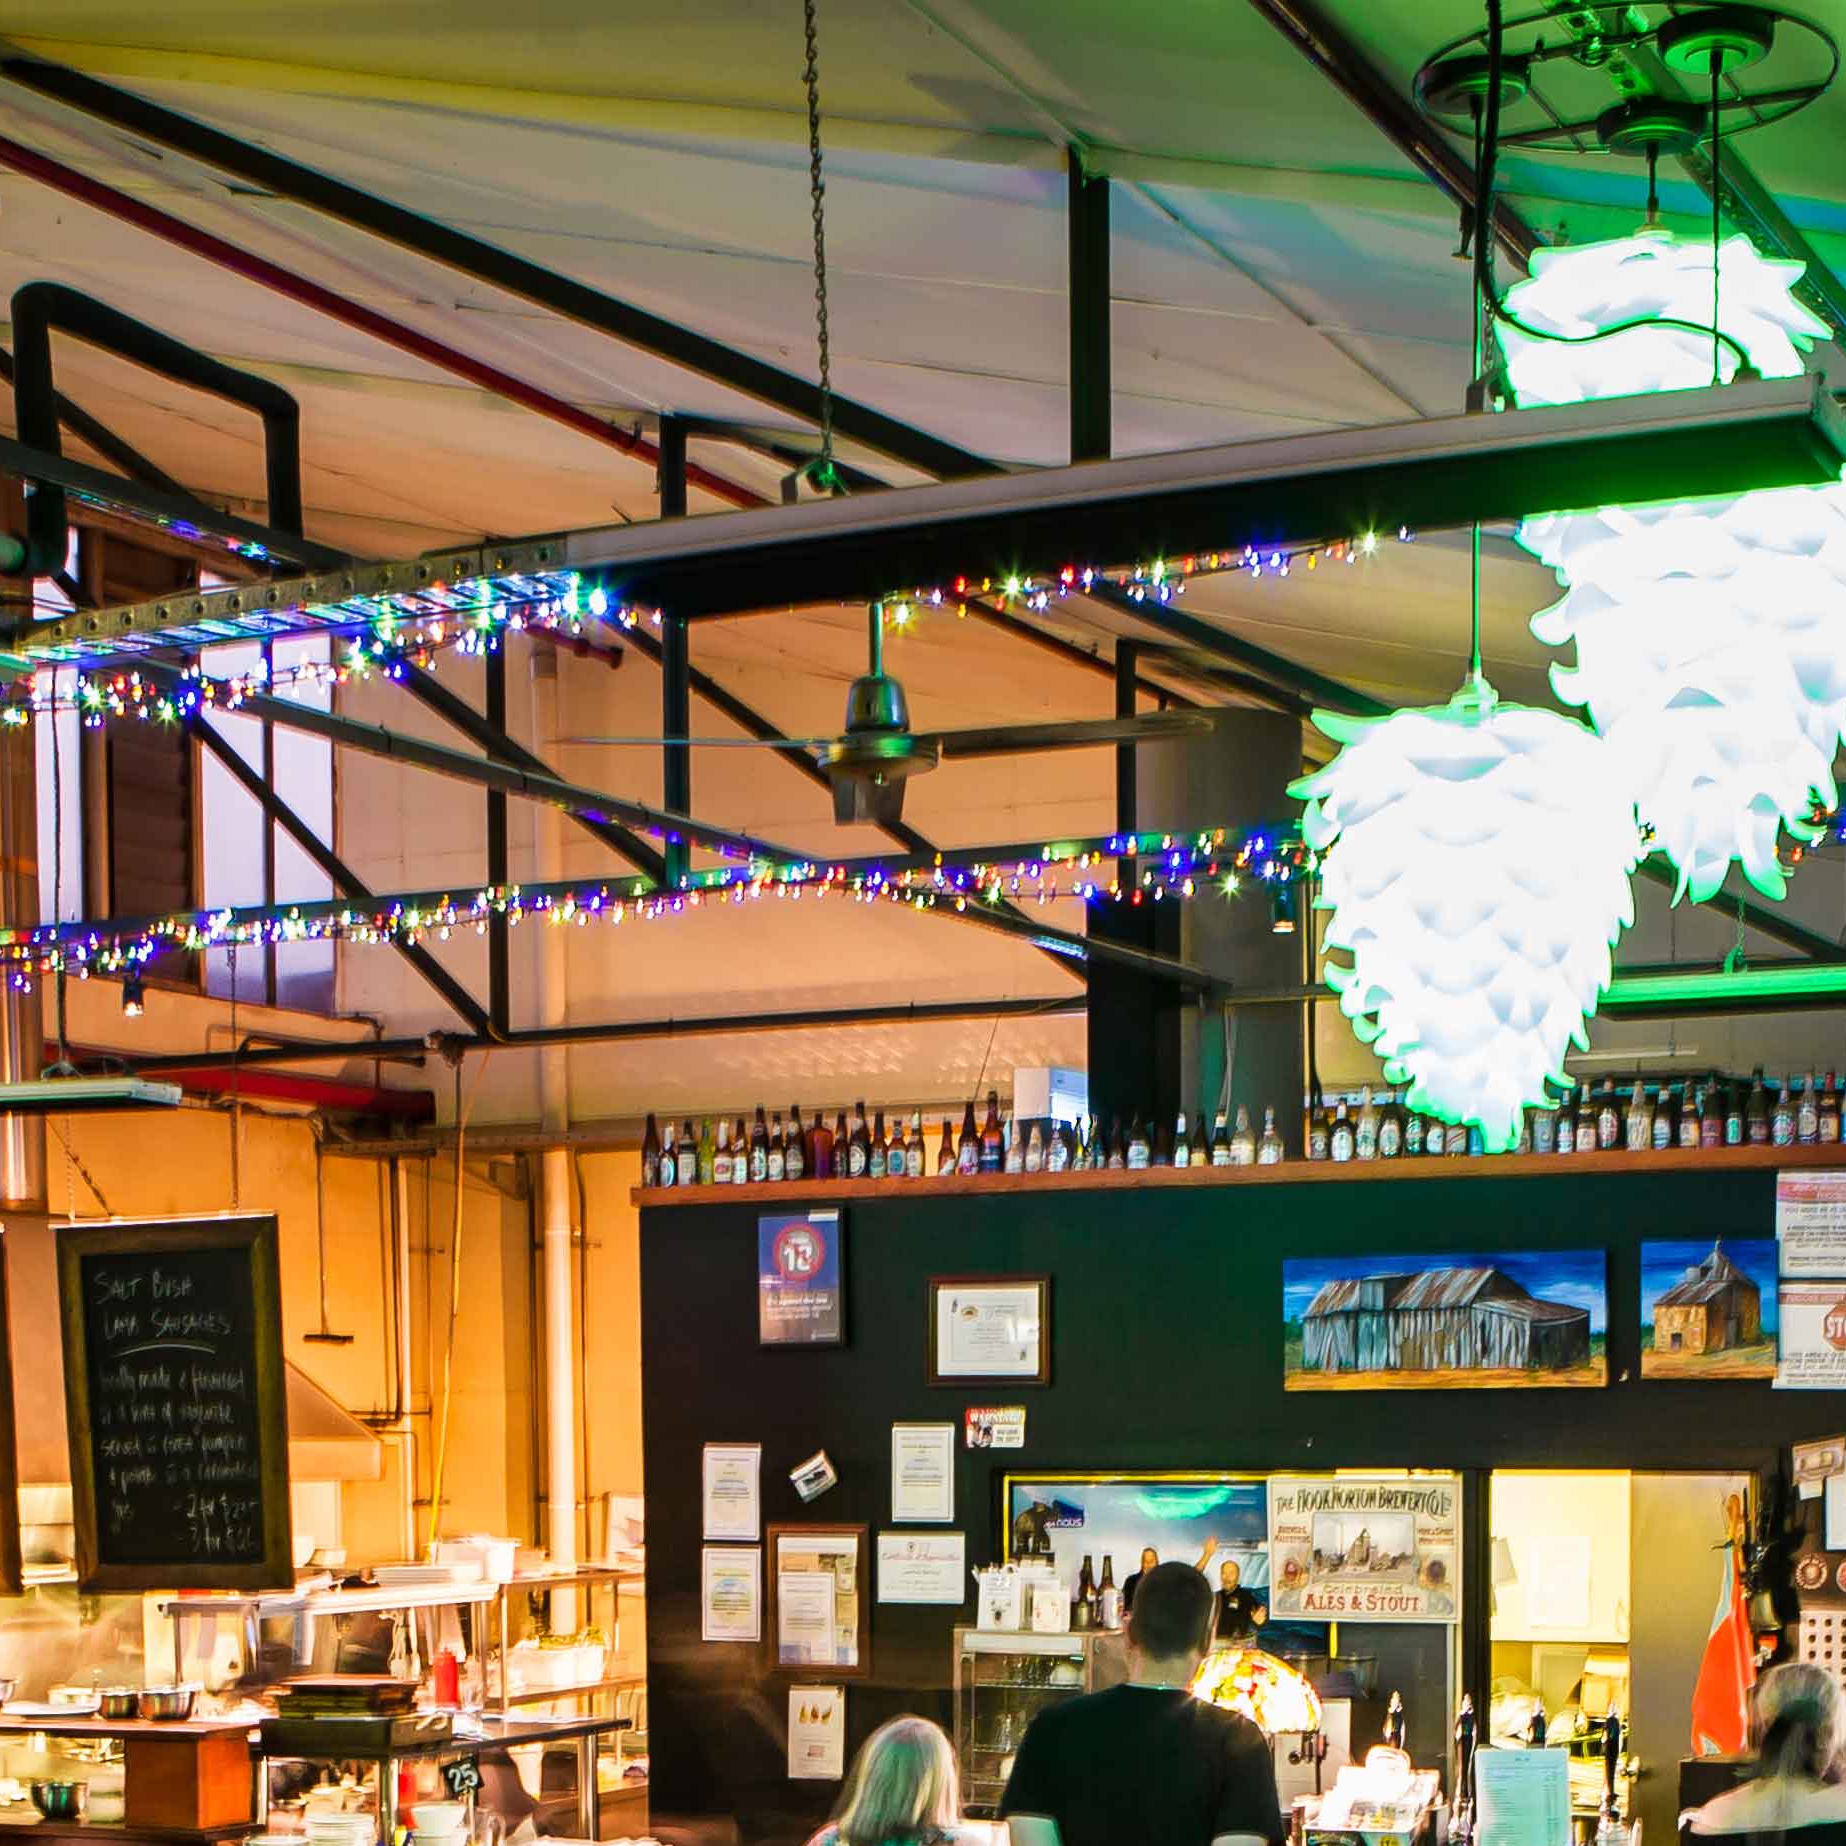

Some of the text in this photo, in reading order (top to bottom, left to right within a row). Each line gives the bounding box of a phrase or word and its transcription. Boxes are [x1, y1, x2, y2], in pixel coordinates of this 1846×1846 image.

[93, 1271, 192, 1304] SALT BUSH
[1305, 1594, 1345, 1611] ALES
[1350, 1595, 1361, 1611] &
[448, 1763, 478, 1792] 25
